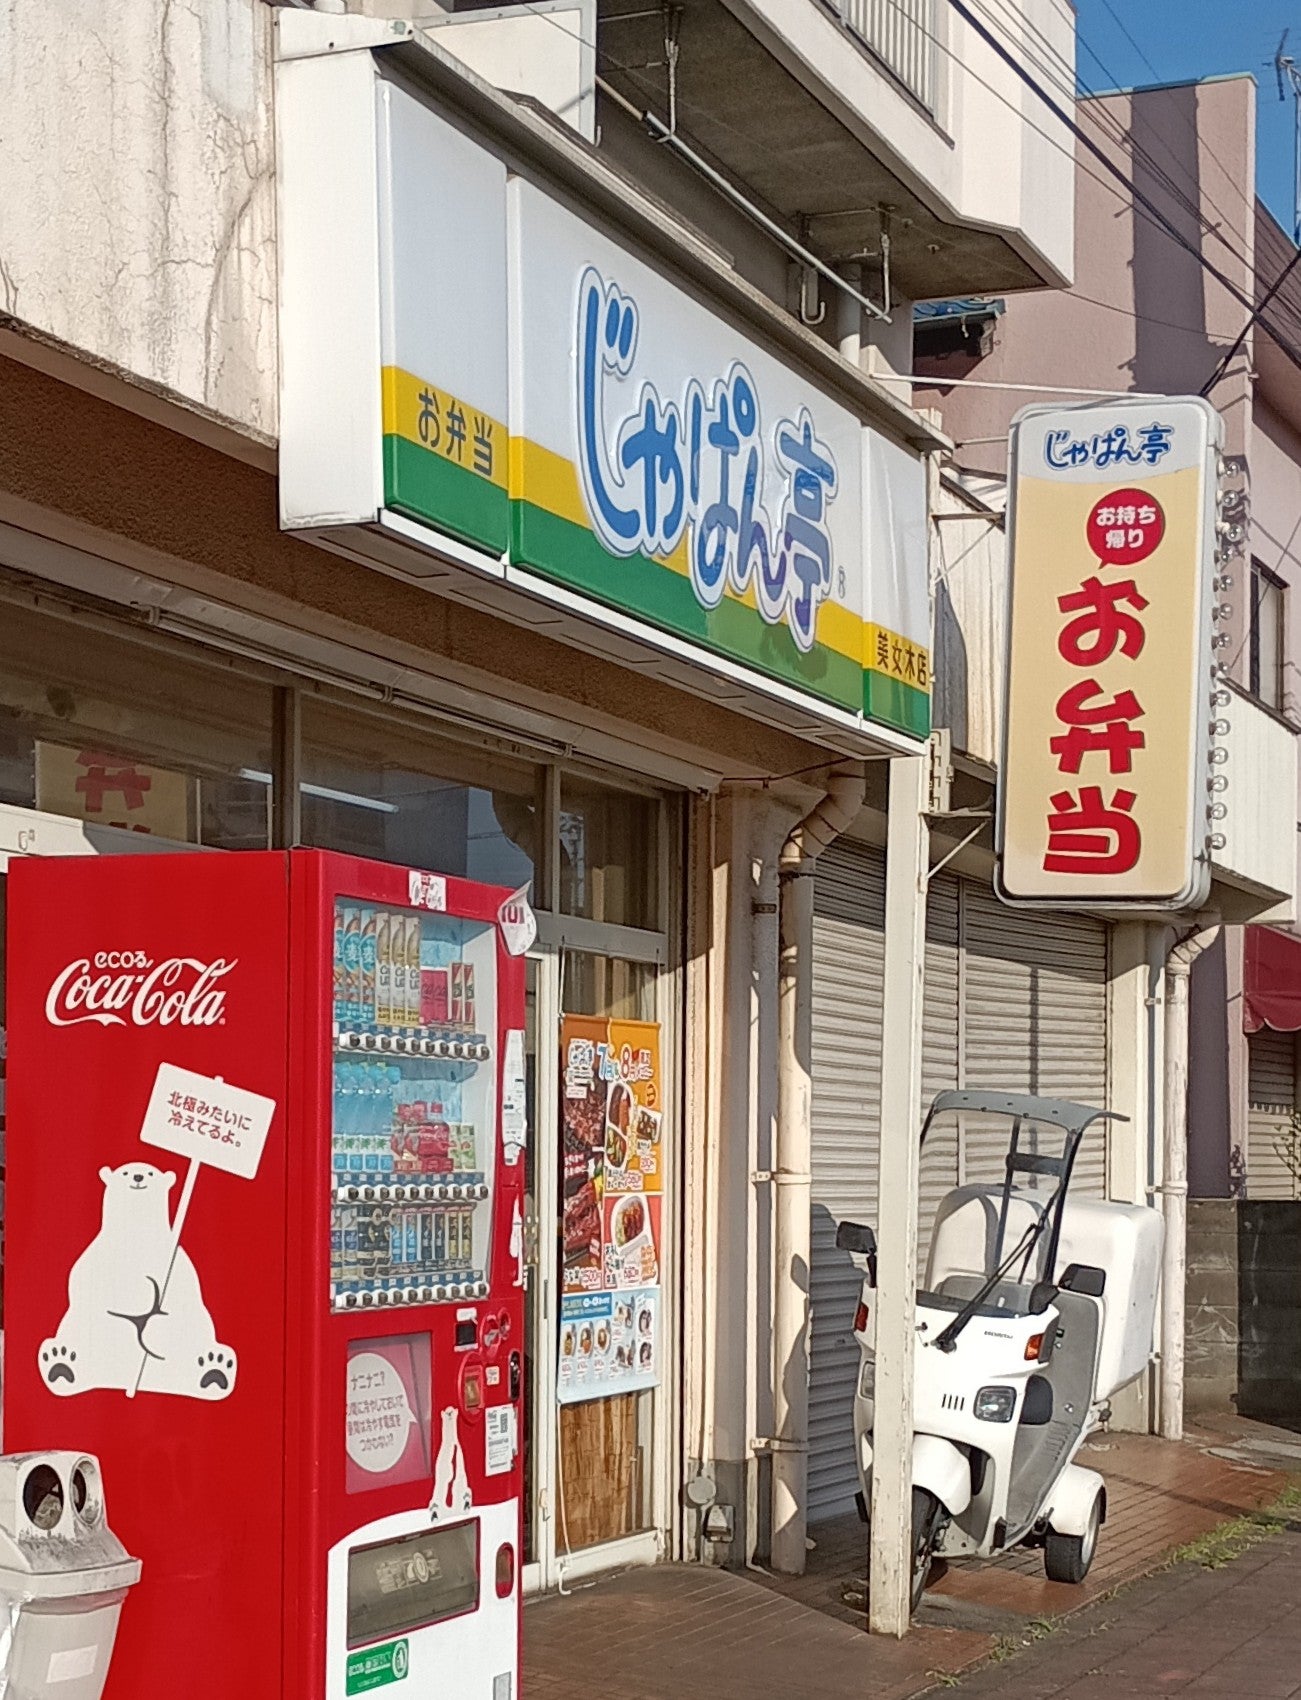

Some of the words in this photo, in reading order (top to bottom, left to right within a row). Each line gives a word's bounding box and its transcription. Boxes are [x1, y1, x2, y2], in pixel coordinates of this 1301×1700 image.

[419, 387, 492, 476] お弁当
[1045, 423, 1173, 469] じゃぱん亭
[581, 279, 835, 641] じゃぱん亭
[1096, 505, 1156, 526] お持ち
[1105, 528, 1144, 549] 帰り
[877, 629, 926, 686] 美女木店
[1043, 576, 1150, 875] お弁当
[46, 958, 238, 1026] Coca-Cola
[167, 1091, 252, 1130] 北極みたいに
[167, 1109, 241, 1147] 冷えてるよ。
